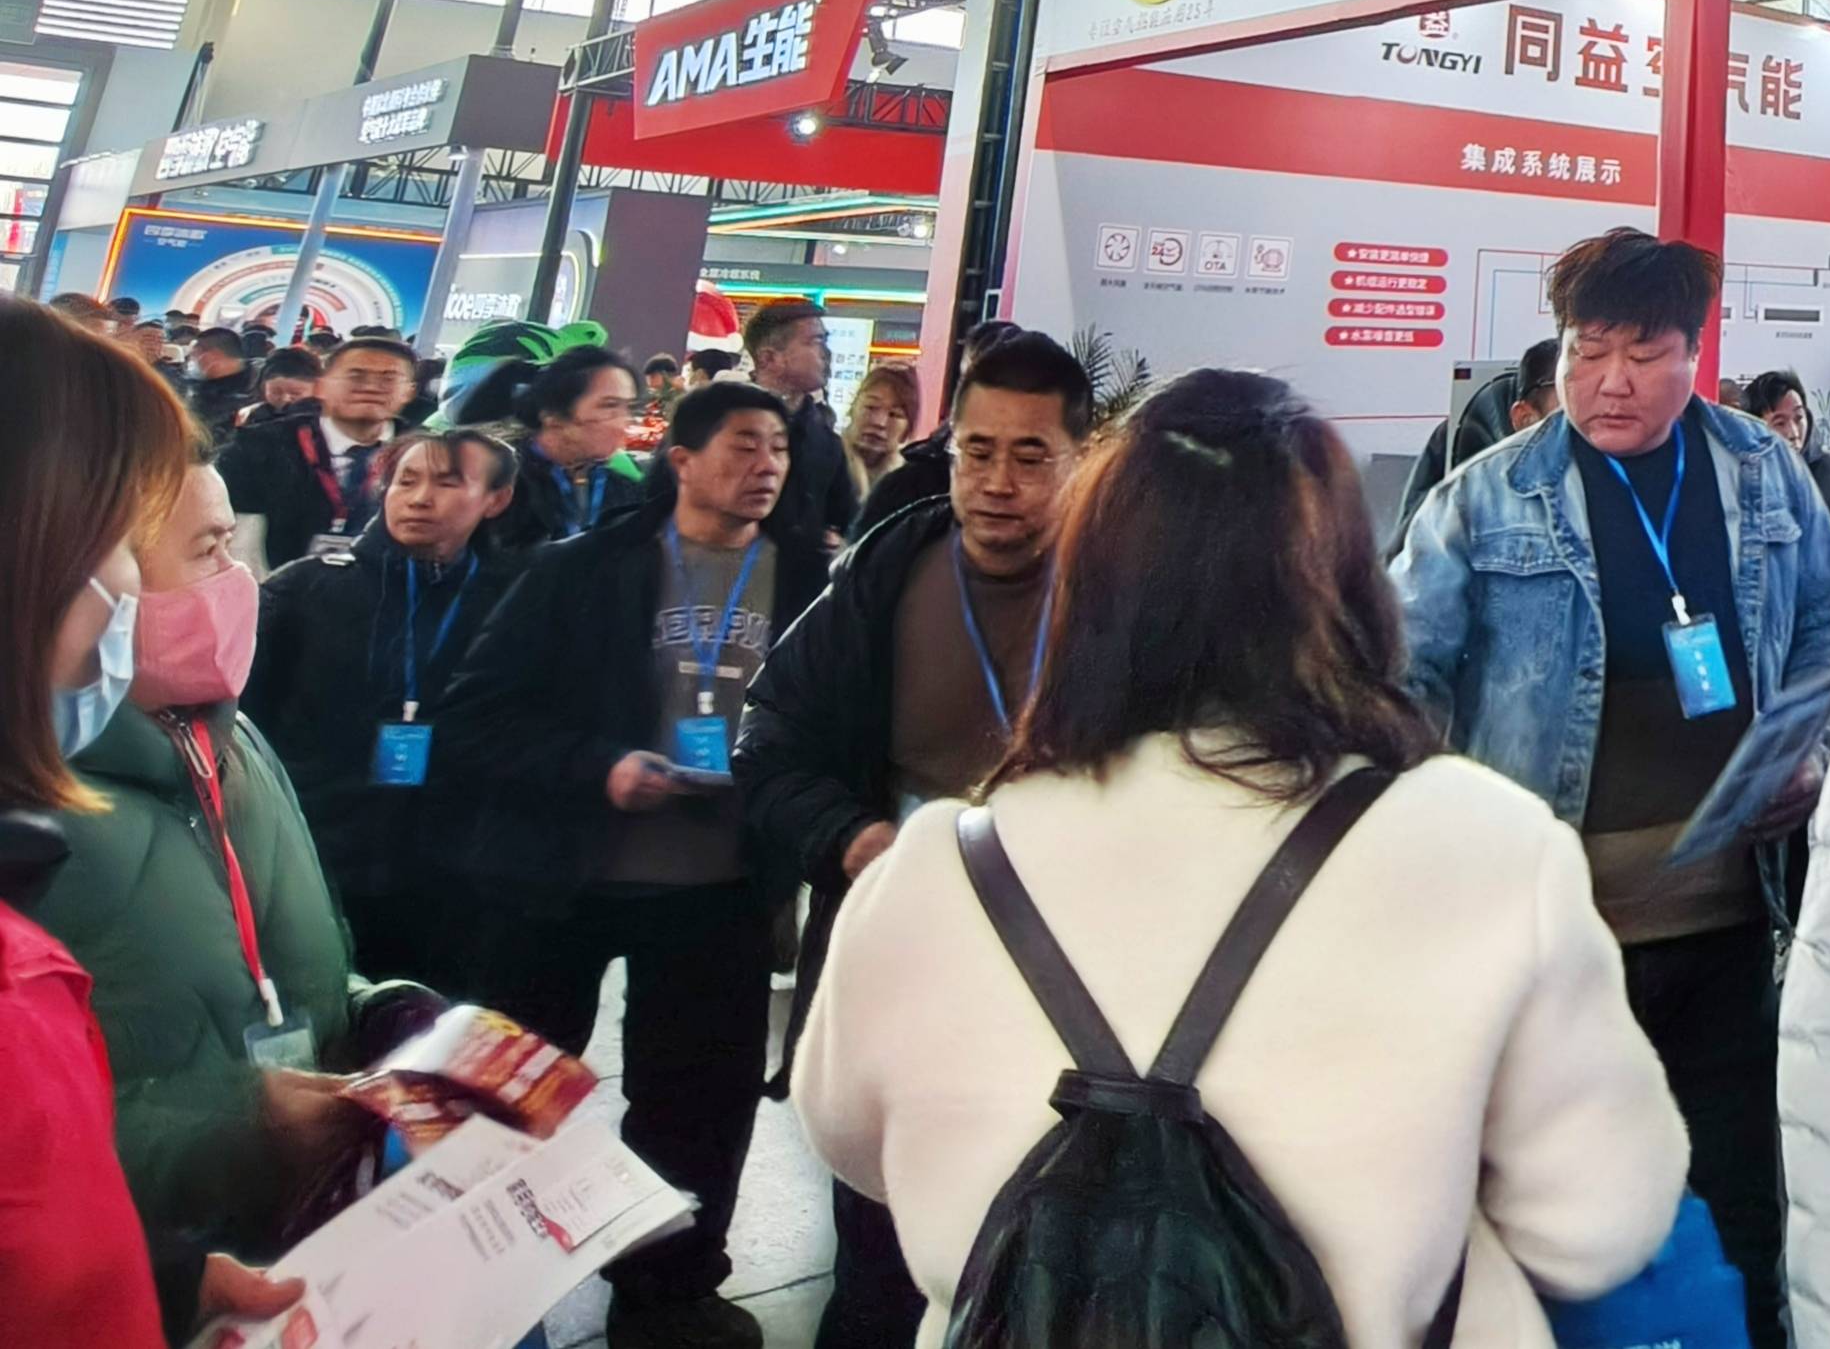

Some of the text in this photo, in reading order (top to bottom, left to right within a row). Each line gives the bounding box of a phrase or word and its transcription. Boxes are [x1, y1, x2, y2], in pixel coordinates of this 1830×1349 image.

[1381, 42, 1482, 75] TONGYI
[1460, 143, 1622, 186] 集成系统展示
[1204, 260, 1227, 271] OTA
